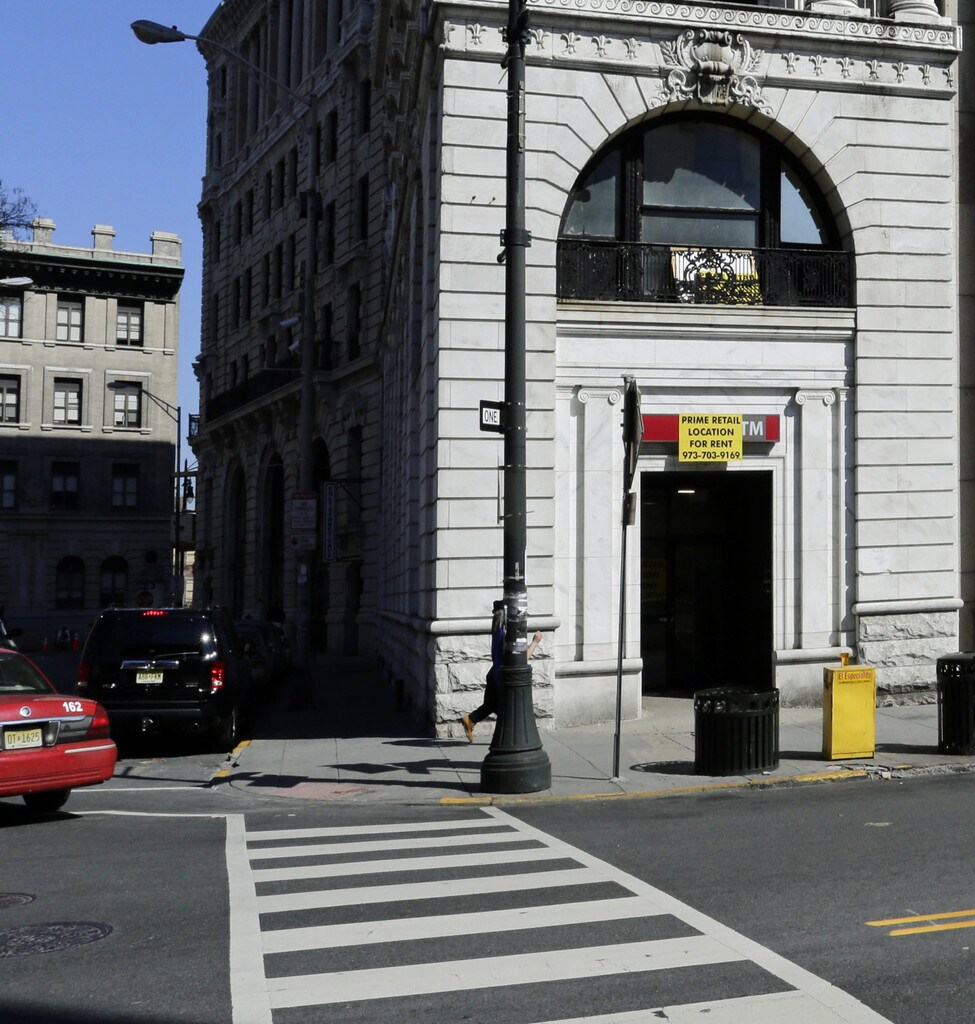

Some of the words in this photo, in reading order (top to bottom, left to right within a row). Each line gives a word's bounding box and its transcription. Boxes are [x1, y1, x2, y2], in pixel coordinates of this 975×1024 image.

[484, 410, 498, 423] ONE
[682, 416, 709, 424] PRIME
[712, 416, 741, 424] RETAIL
[688, 428, 734, 436] LOCATION
[742, 421, 764, 435] TM
[690, 440, 708, 448] FOR
[711, 440, 733, 448] RENT
[682, 451, 740, 459] 973-703-9169
[63, 701, 84, 712] 162
